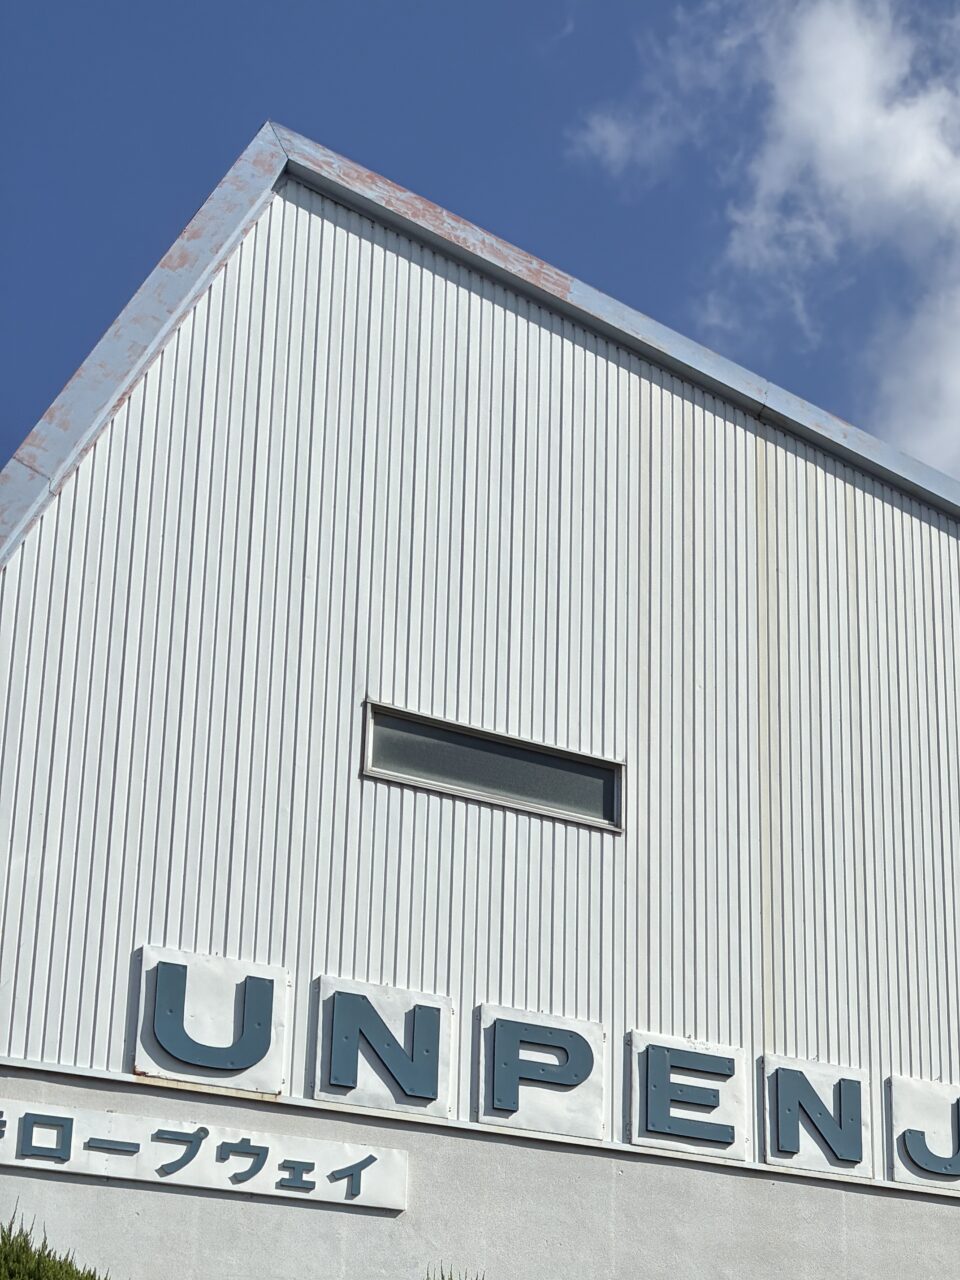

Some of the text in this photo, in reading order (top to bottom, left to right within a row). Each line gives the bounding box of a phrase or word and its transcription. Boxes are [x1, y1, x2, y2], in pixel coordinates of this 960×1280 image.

[0, 1110, 378, 1197] ロープウェイ
